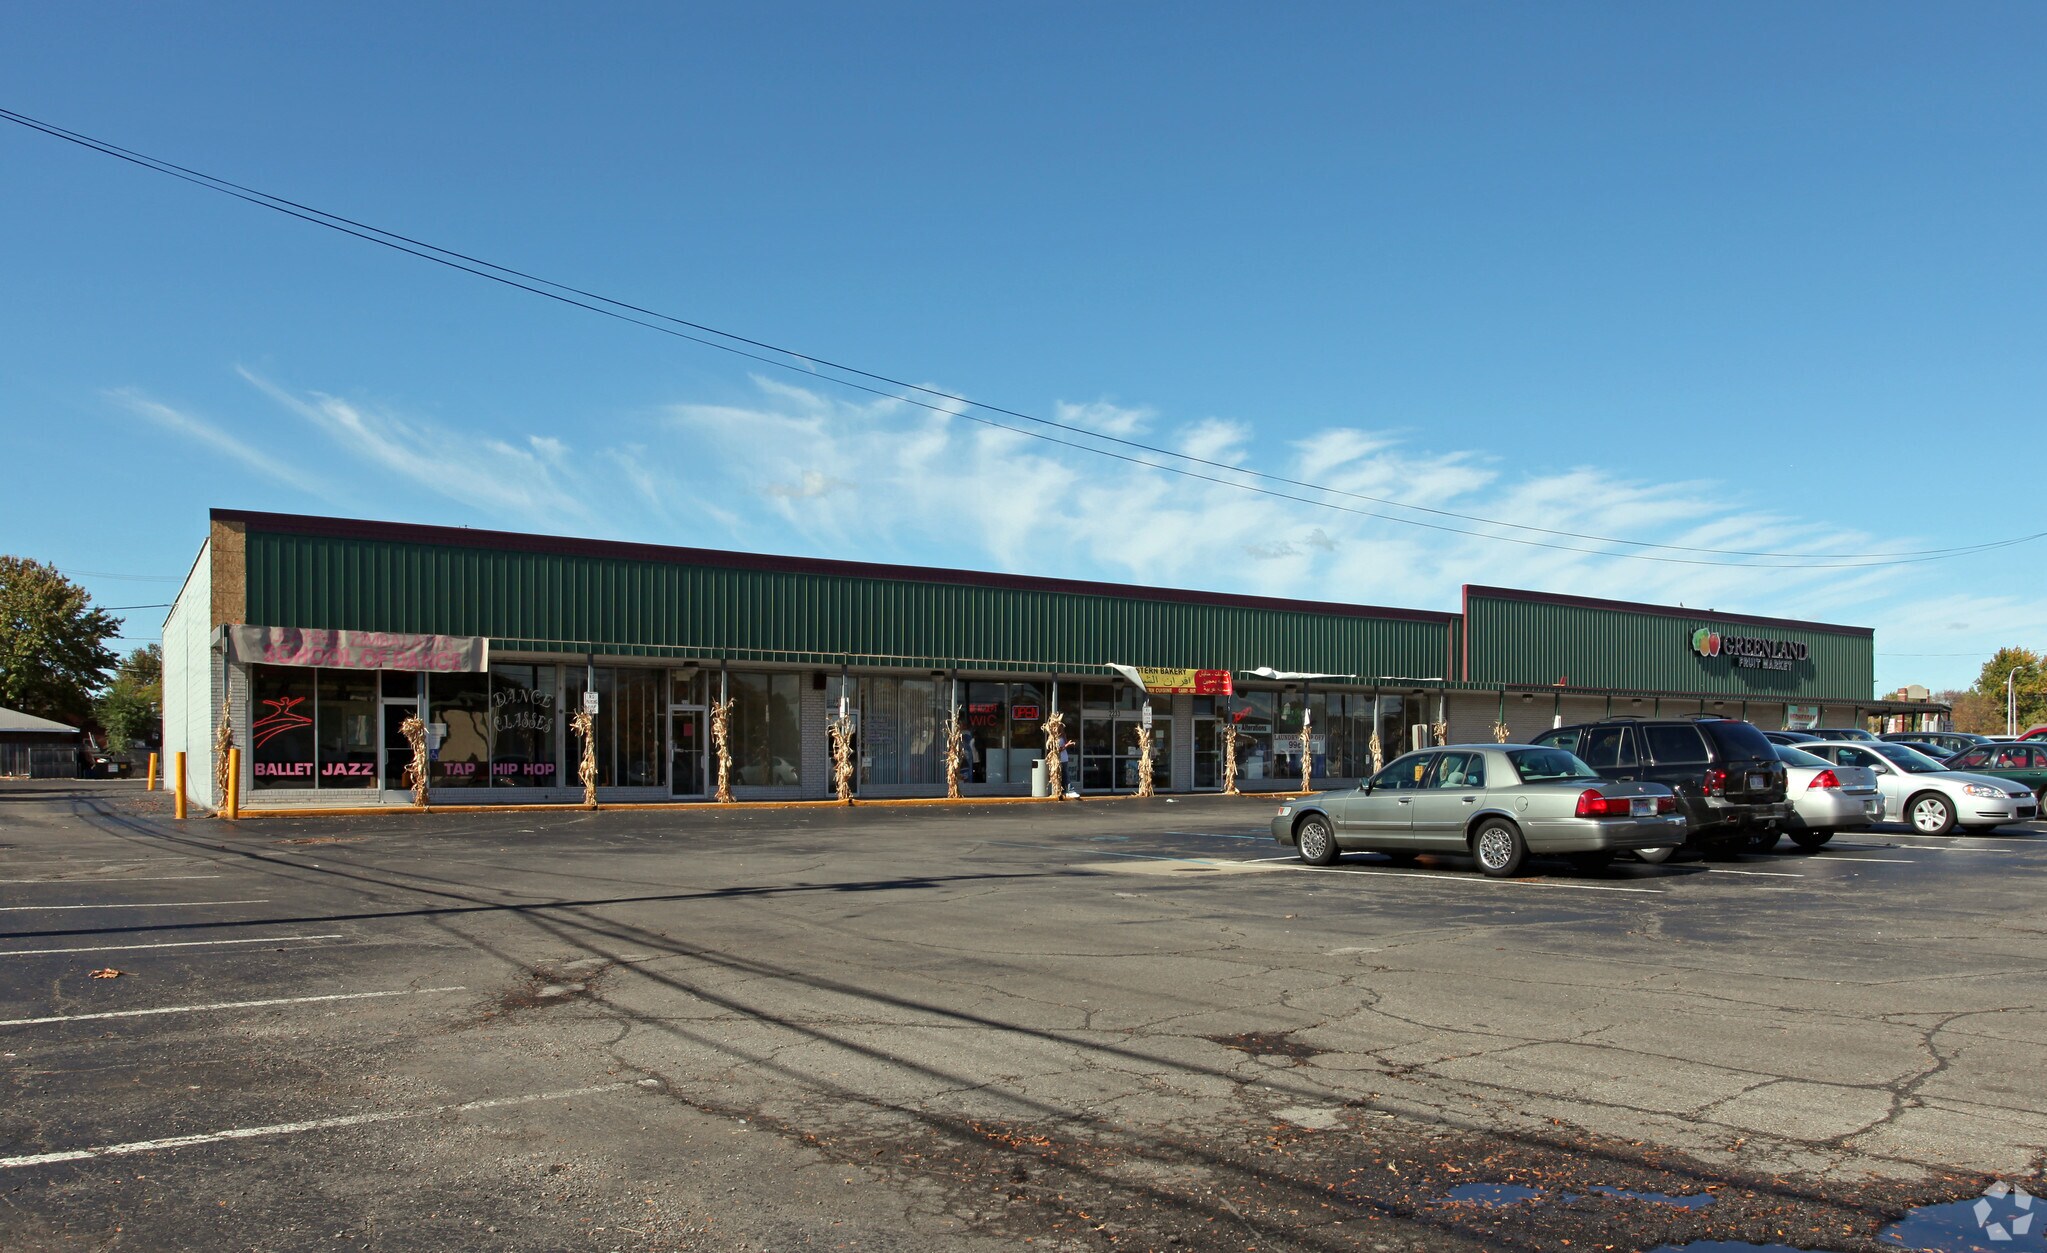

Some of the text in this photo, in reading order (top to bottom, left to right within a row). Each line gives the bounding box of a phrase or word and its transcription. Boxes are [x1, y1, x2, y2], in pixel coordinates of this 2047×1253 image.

[1723, 635, 1809, 661] GREENLAND
[263, 643, 462, 671] SCHOOL OF DANCE
[1739, 658, 1793, 671] FRUIT MARKET
[493, 687, 555, 708] DANCE
[970, 715, 998, 726] WIC
[1014, 707, 1038, 718] OPEN
[493, 711, 553, 733] CLASSES
[254, 763, 555, 776] BALLET JAZZ TAP HIP HOP
